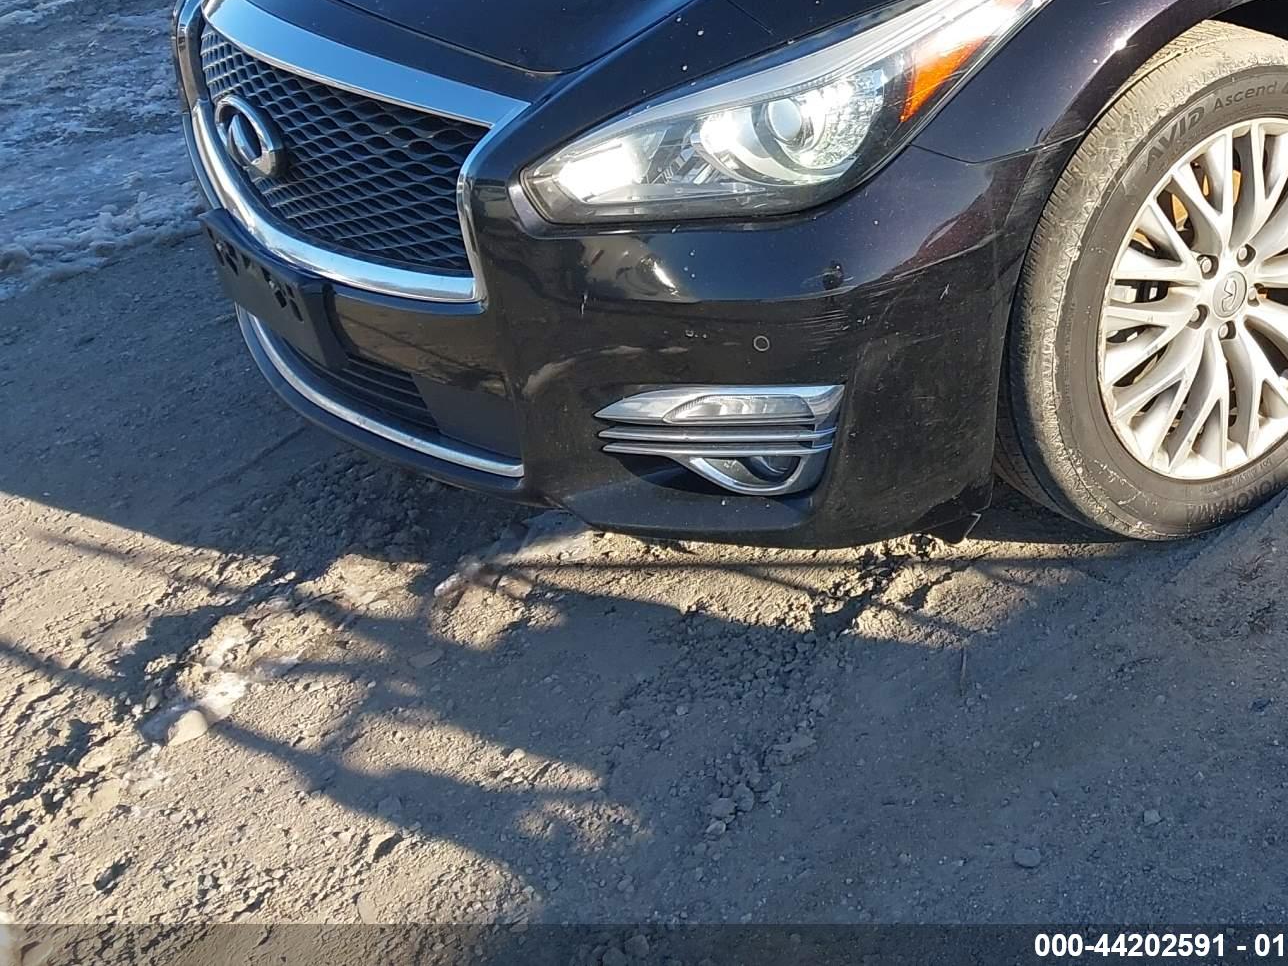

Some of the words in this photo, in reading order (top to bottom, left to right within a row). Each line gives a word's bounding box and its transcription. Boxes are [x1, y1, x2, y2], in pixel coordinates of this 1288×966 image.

[1143, 104, 1207, 175] AVID
[1212, 80, 1278, 113] Ascend
[1186, 475, 1282, 524] YOKOHAMA
